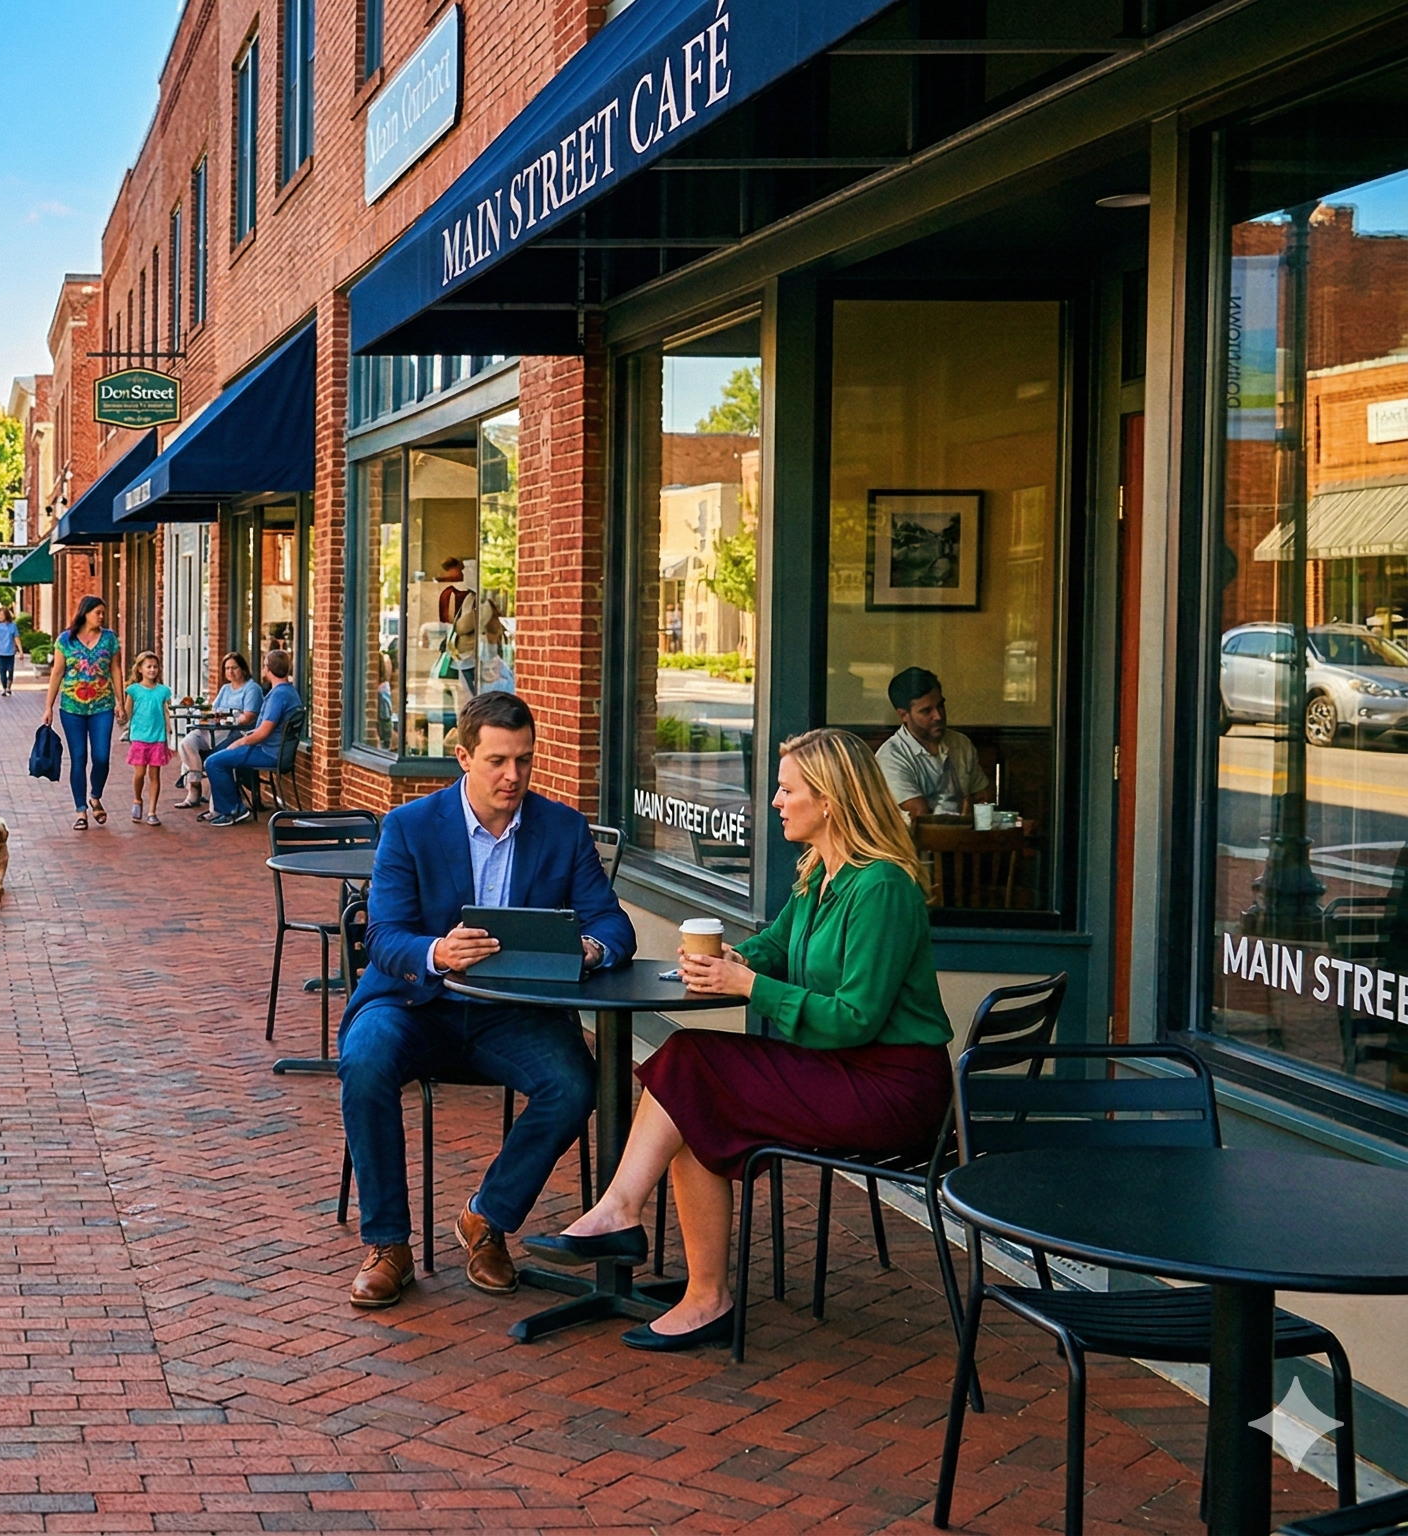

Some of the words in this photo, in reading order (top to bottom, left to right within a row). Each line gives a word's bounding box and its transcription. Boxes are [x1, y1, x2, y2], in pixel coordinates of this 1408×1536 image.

[442, 189, 503, 286] MAIN
[509, 98, 619, 240] STREET
[630, 0, 732, 154] CAFÉ
[131, 385, 175, 400] Street
[633, 788, 664, 823] MAIN
[665, 796, 710, 835] STREET
[711, 806, 745, 847] CAFÉ
[1223, 932, 1303, 995] MAIN
